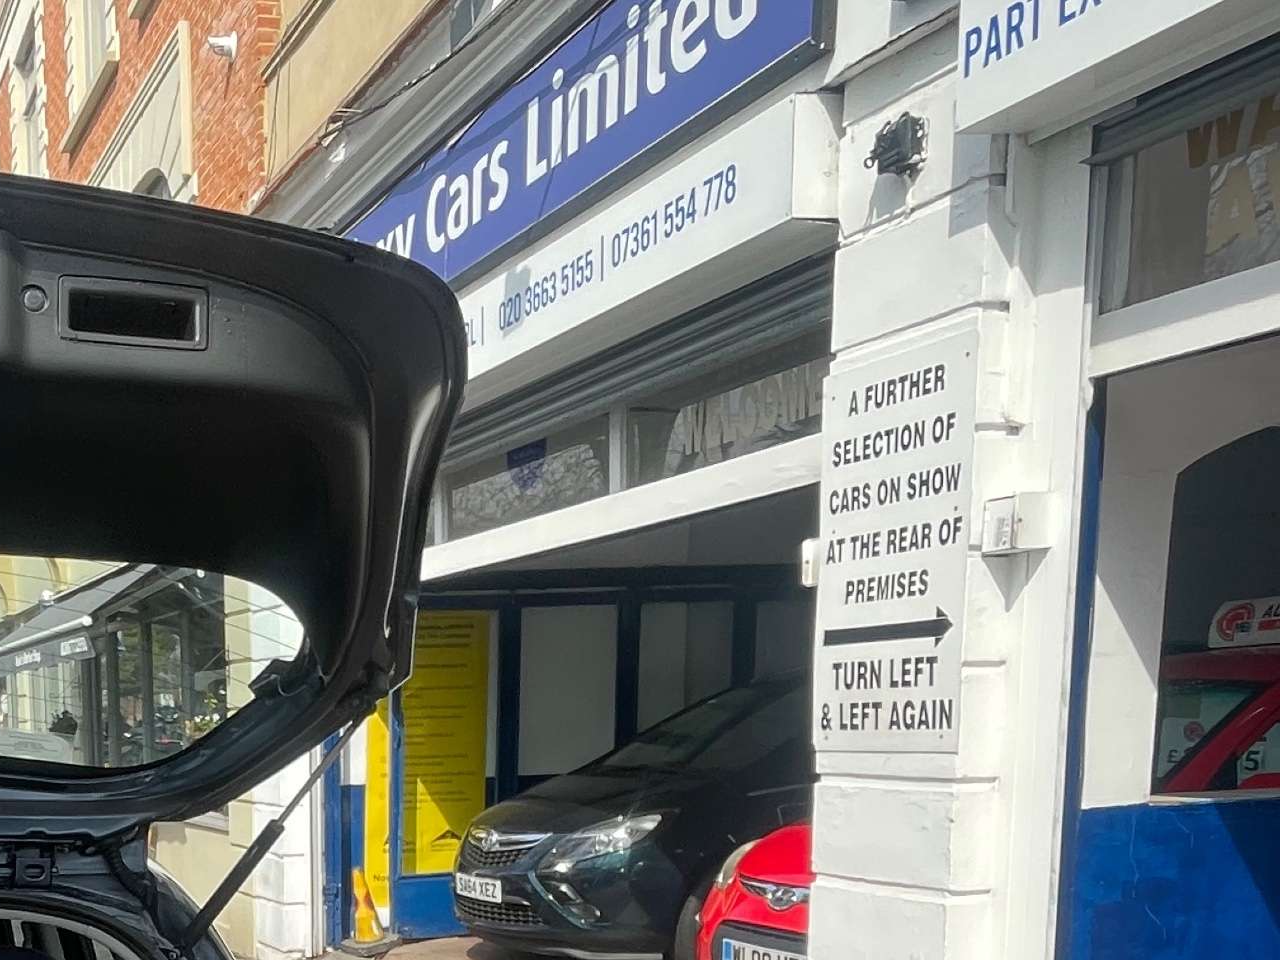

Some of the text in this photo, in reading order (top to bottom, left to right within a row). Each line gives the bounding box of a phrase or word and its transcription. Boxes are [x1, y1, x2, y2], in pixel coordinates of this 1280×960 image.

[964, 0, 1039, 78] PART
[426, 139, 509, 253] Cars
[499, 292, 522, 330] 020
[525, 271, 557, 316] 3663
[561, 249, 593, 296] 5155
[612, 208, 658, 268] 07361
[664, 187, 697, 239] 554
[703, 163, 737, 217] 778
[848, 364, 946, 417] A FURTHER
[832, 412, 956, 467] SELECTION OF
[829, 463, 961, 515] CARS ON SHOW
[826, 516, 963, 565] AT THE REAR OF
[845, 569, 929, 605] PREMISES
[832, 656, 938, 690] TURN LEFT
[821, 699, 953, 731] & LEFT AGAIN
